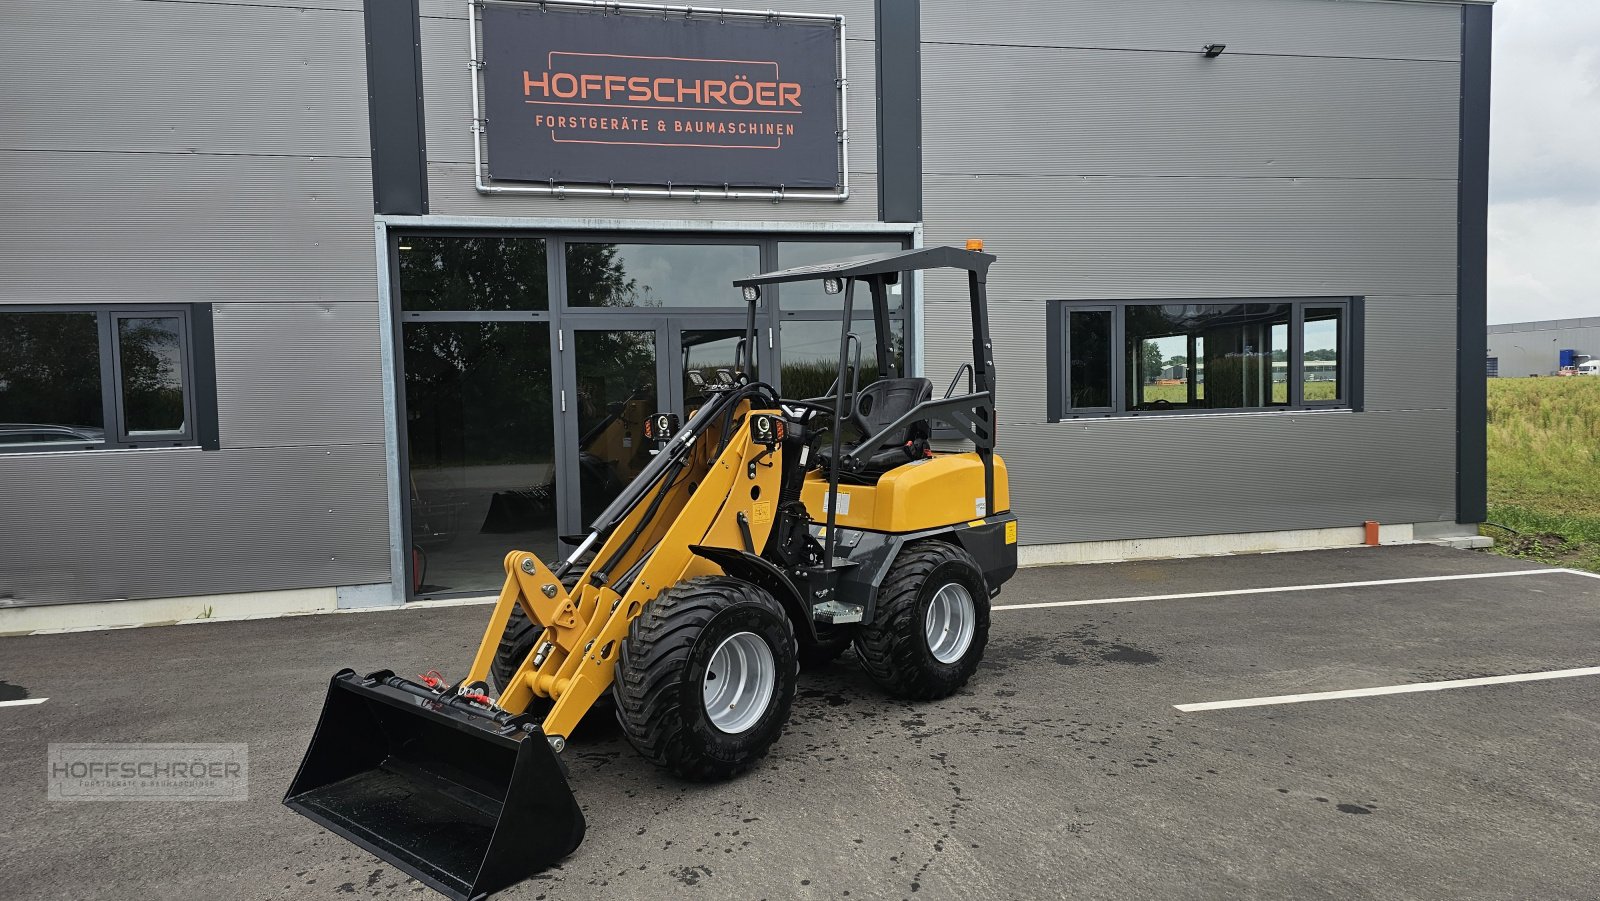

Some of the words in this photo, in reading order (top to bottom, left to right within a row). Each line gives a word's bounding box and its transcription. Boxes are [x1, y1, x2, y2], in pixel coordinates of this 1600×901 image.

[523, 70, 803, 107] HOFFSCHRÖER
[535, 114, 650, 132] FORSTGERÄTE
[657, 121, 667, 133] &
[674, 120, 796, 136] BAUMASCHINEN
